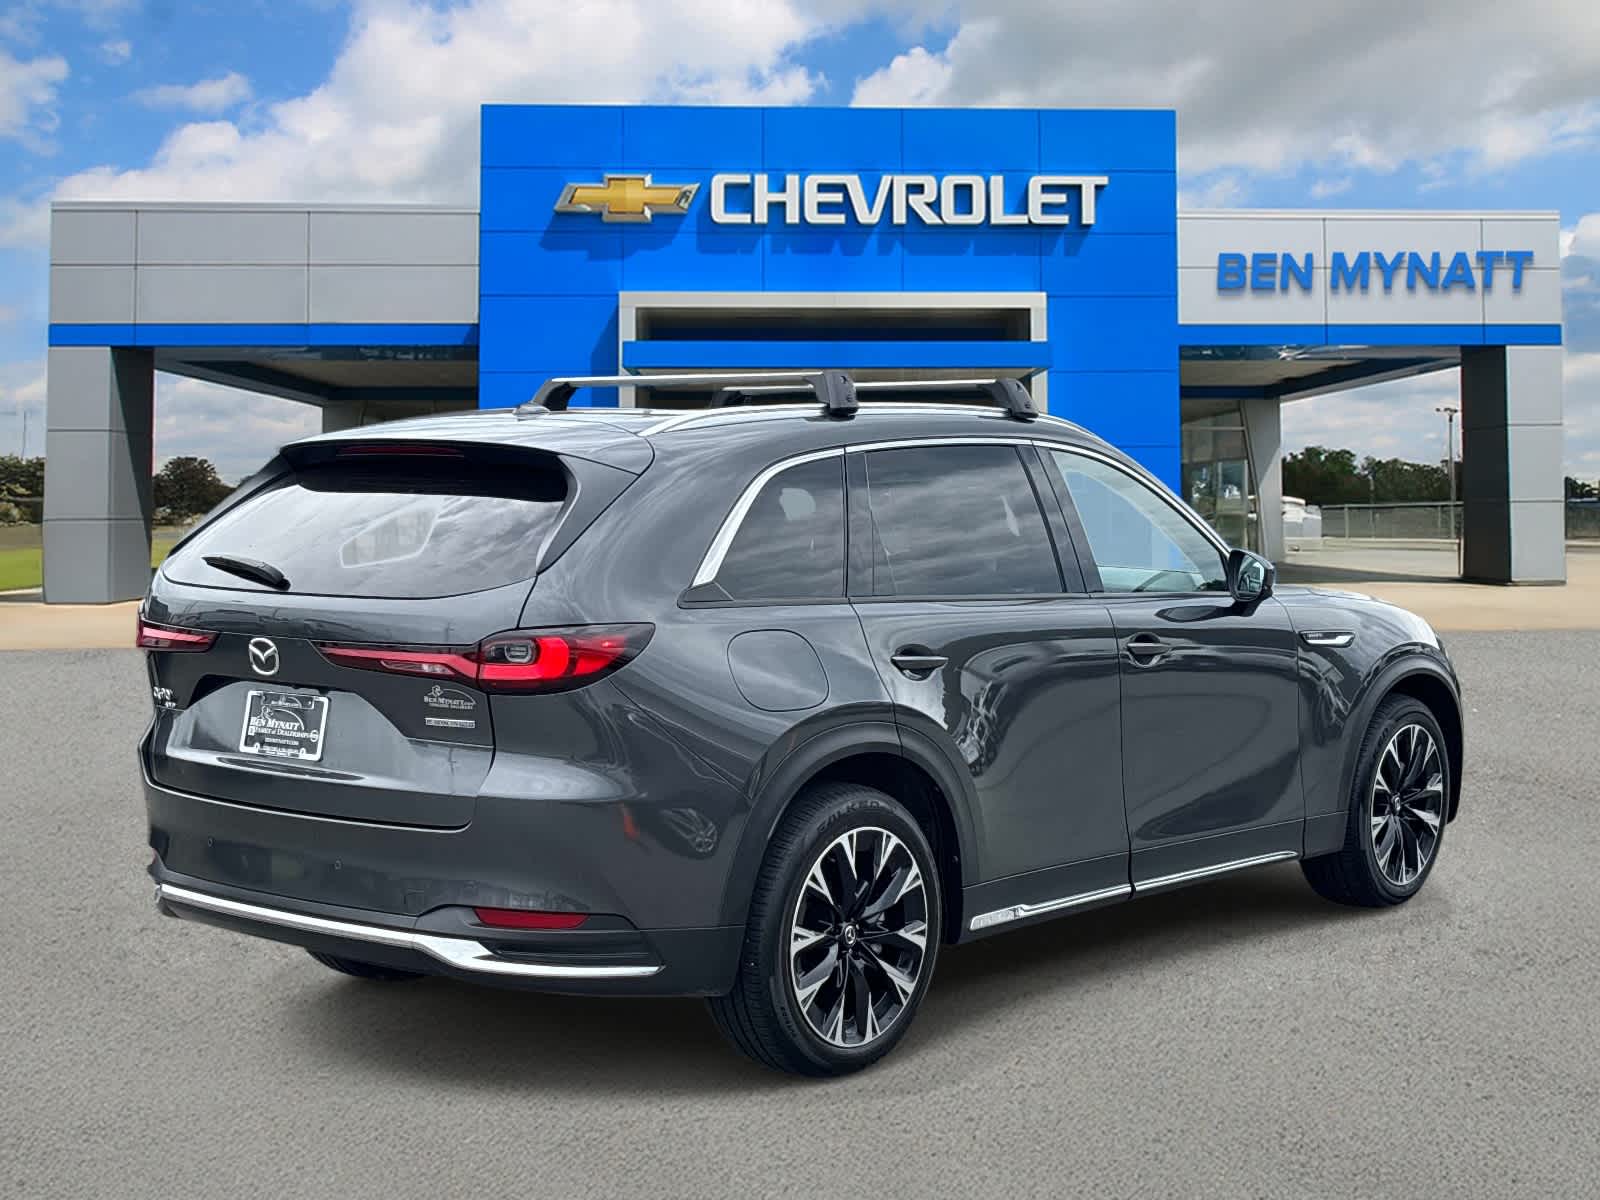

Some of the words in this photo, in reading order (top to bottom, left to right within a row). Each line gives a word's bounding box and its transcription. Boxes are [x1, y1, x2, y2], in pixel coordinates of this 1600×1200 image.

[710, 174, 1109, 225] CHEVROLET
[1217, 252, 1313, 291] BEN
[1330, 250, 1534, 291] MYNATT
